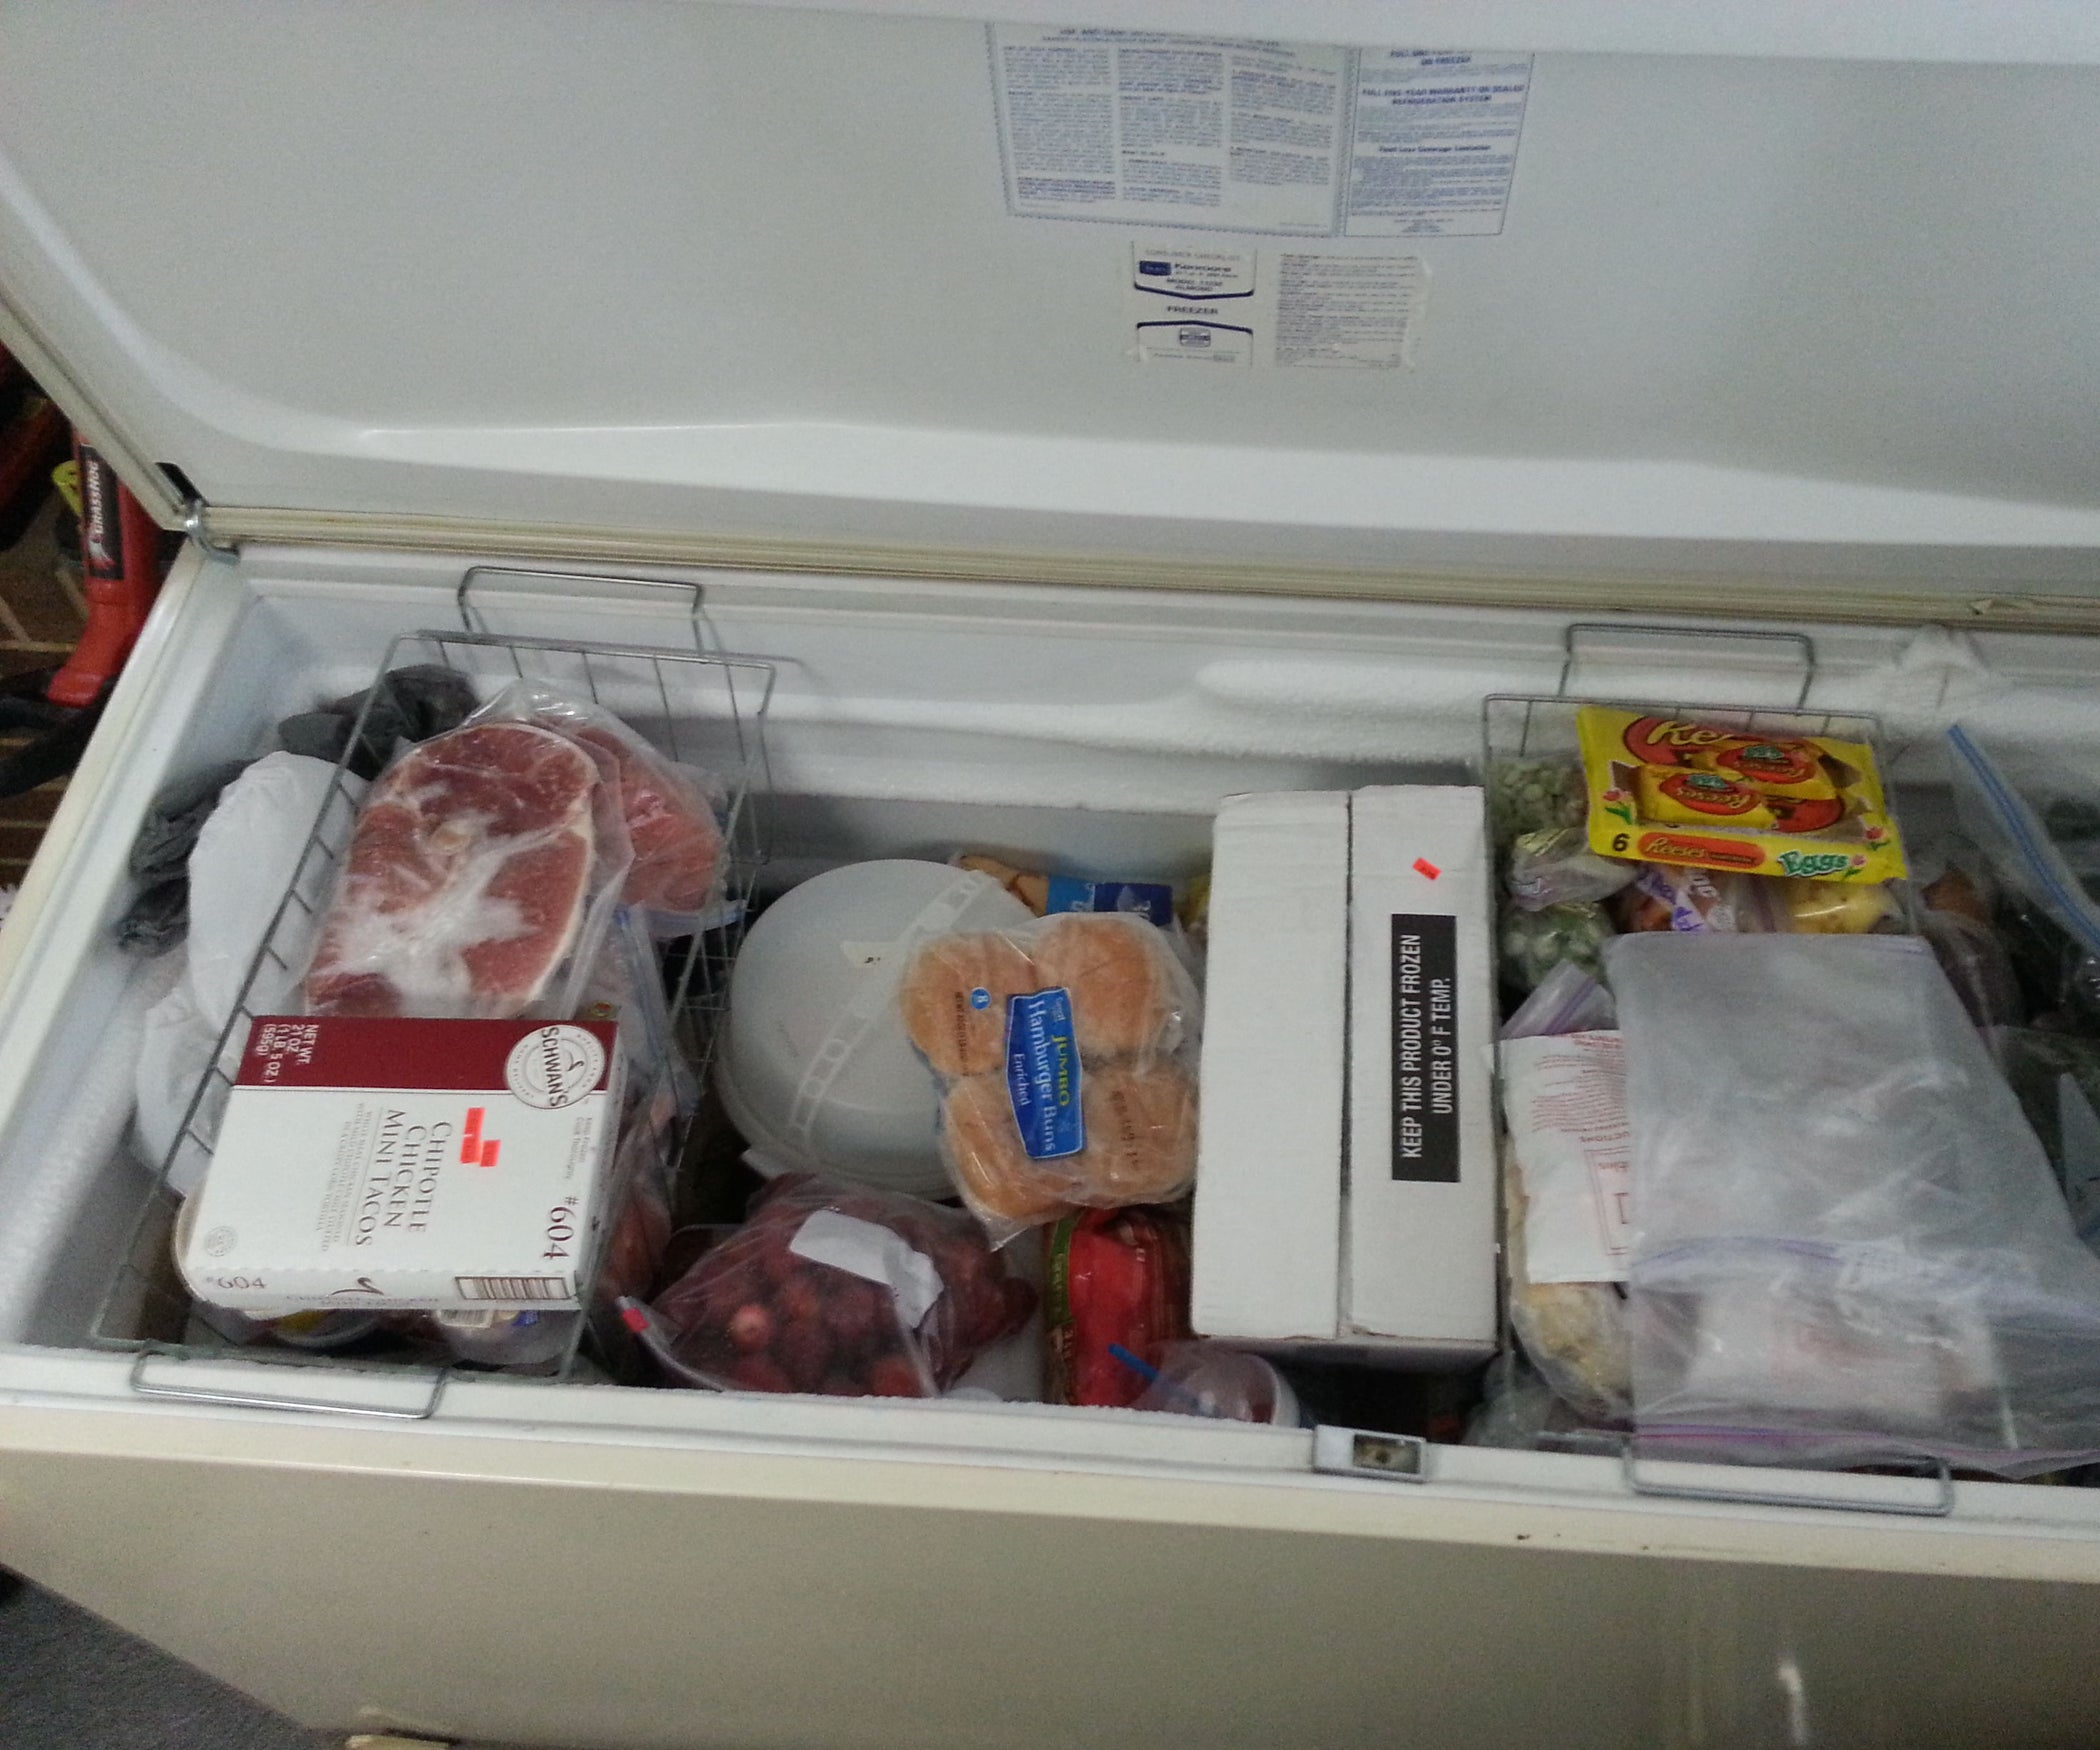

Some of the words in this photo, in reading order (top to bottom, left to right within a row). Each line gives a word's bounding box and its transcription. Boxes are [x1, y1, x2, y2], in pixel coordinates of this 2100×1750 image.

[1166, 304, 1219, 315] FREEZER
[1612, 832, 1631, 852] 6
[1778, 850, 1848, 876] Eggs
[1399, 933, 1421, 994] FROZEN
[1430, 977, 1451, 1021] TEMP.
[256, 1023, 277, 1056] (595g)
[291, 1024, 304, 1036] 21
[304, 1023, 319, 1044] NET
[1399, 998, 1422, 1071] PRODUCT
[1430, 1025, 1451, 1036] F
[540, 1026, 570, 1107] SCHWAN'S
[1013, 1053, 1031, 1106] Enriched
[1027, 1000, 1053, 1101] Hamburger
[1041, 1106, 1057, 1151] Buns
[1051, 1034, 1070, 1106] JUMBO
[1400, 1076, 1423, 1111] THIS
[1430, 1060, 1453, 1114] UNDER
[375, 1109, 407, 1164] MINI
[1400, 1115, 1423, 1159] KEEP
[383, 1125, 427, 1229] CHICKEN
[408, 1121, 453, 1233] CHIPOTLE
[355, 1171, 392, 1247] TACOS
[541, 1195, 580, 1261] #604
